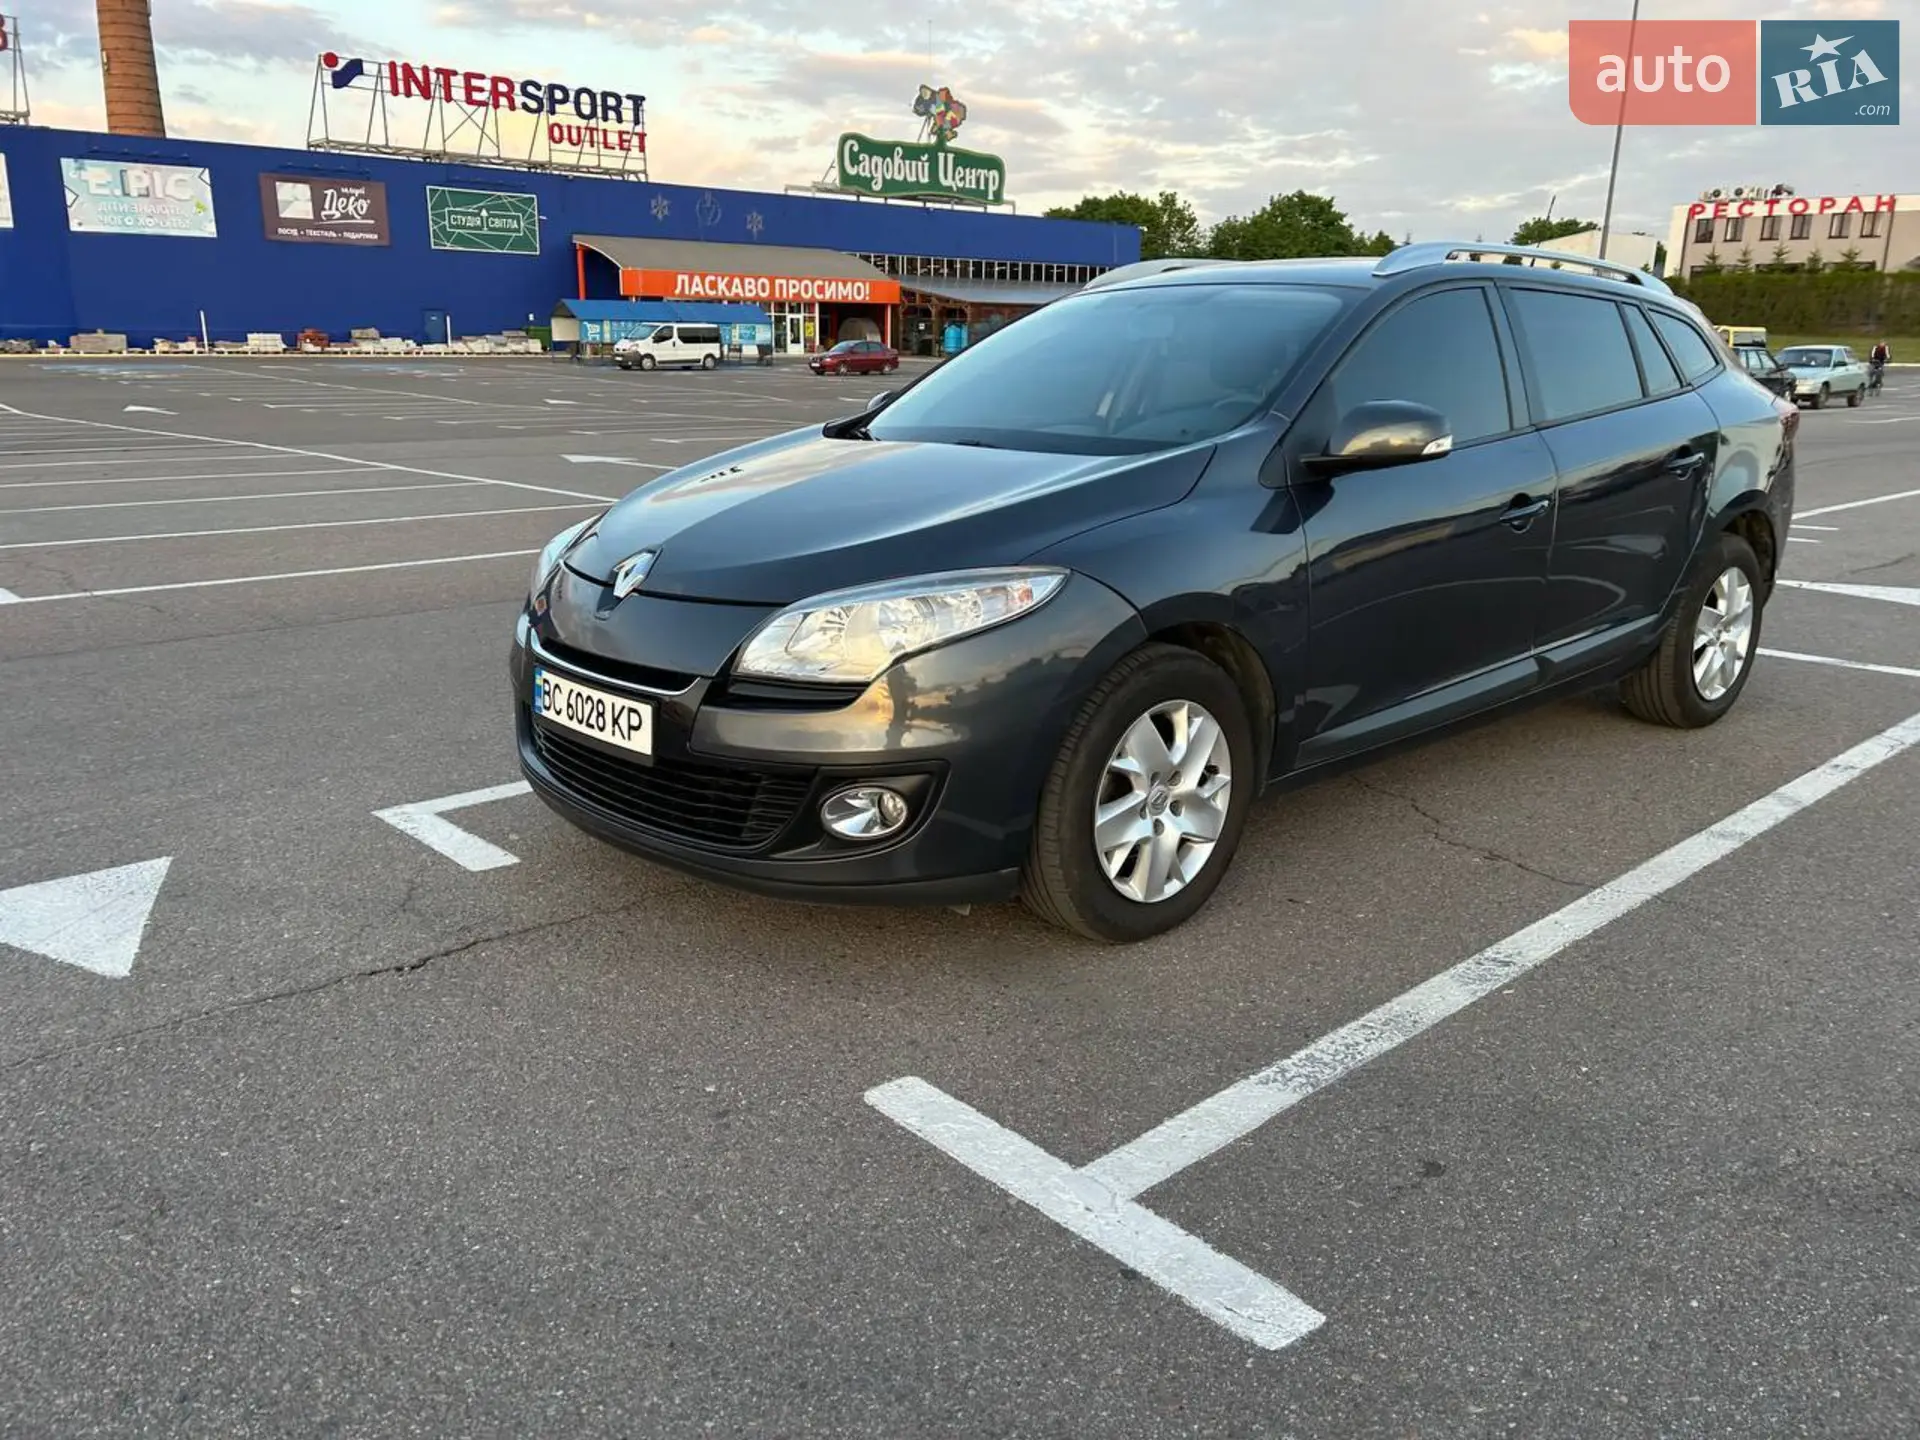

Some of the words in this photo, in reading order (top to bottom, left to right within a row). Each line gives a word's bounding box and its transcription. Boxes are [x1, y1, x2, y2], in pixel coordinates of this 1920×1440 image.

[388, 60, 646, 126] INTERSPORT
[549, 122, 647, 153] OUTLET
[843, 139, 930, 191] Садовий
[938, 152, 1000, 200] Центр
[450, 214, 481, 227] СТУДІЯ
[488, 217, 519, 229] СВІТЛА
[1688, 193, 1896, 221] РЕСТОРАН
[674, 274, 770, 298] ЛАСКАВО
[775, 279, 870, 301] ПРОСИМО!
[542, 678, 563, 716] BC
[567, 689, 606, 733] 6028
[611, 702, 643, 741] KP
